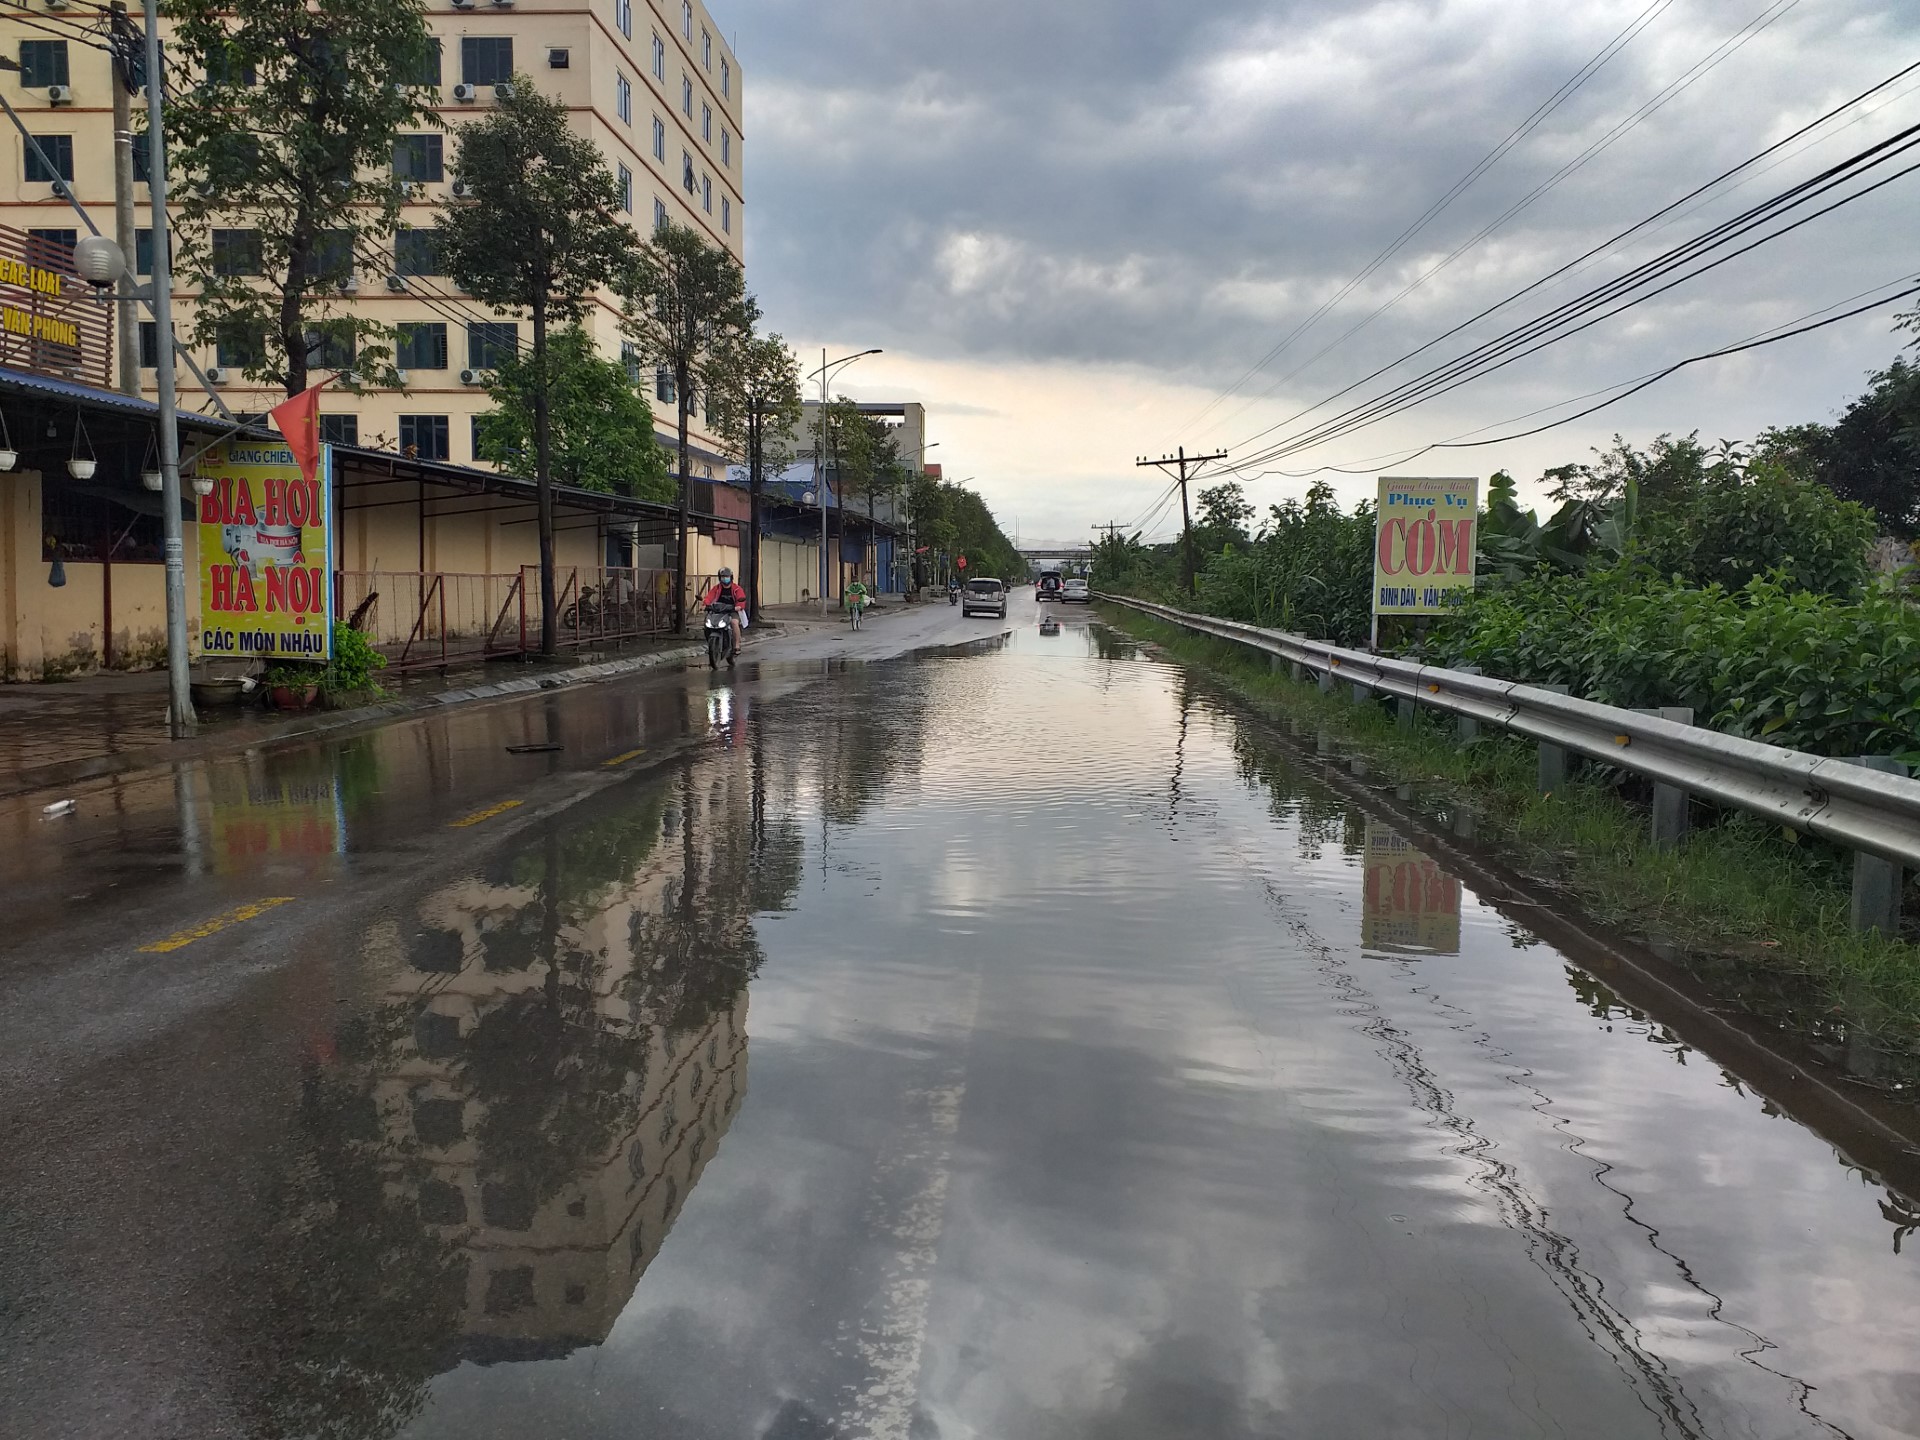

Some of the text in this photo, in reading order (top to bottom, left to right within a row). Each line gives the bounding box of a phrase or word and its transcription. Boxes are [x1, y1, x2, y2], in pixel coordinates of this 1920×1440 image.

[30, 266, 60, 300] LOẠI
[33, 314, 77, 346] PHÒNG
[229, 450, 262, 463] GIANG
[200, 477, 258, 525] BIA
[1388, 493, 1468, 510] Phục Vụ
[1379, 508, 1473, 576] CƠM
[210, 549, 323, 625] HÀ NỘI
[1380, 584, 1398, 606] BÌNH
[1400, 584, 1416, 606] DÂN
[1424, 584, 1439, 606] VĂN
[203, 627, 322, 657] CÁC MÓN NHẬU
